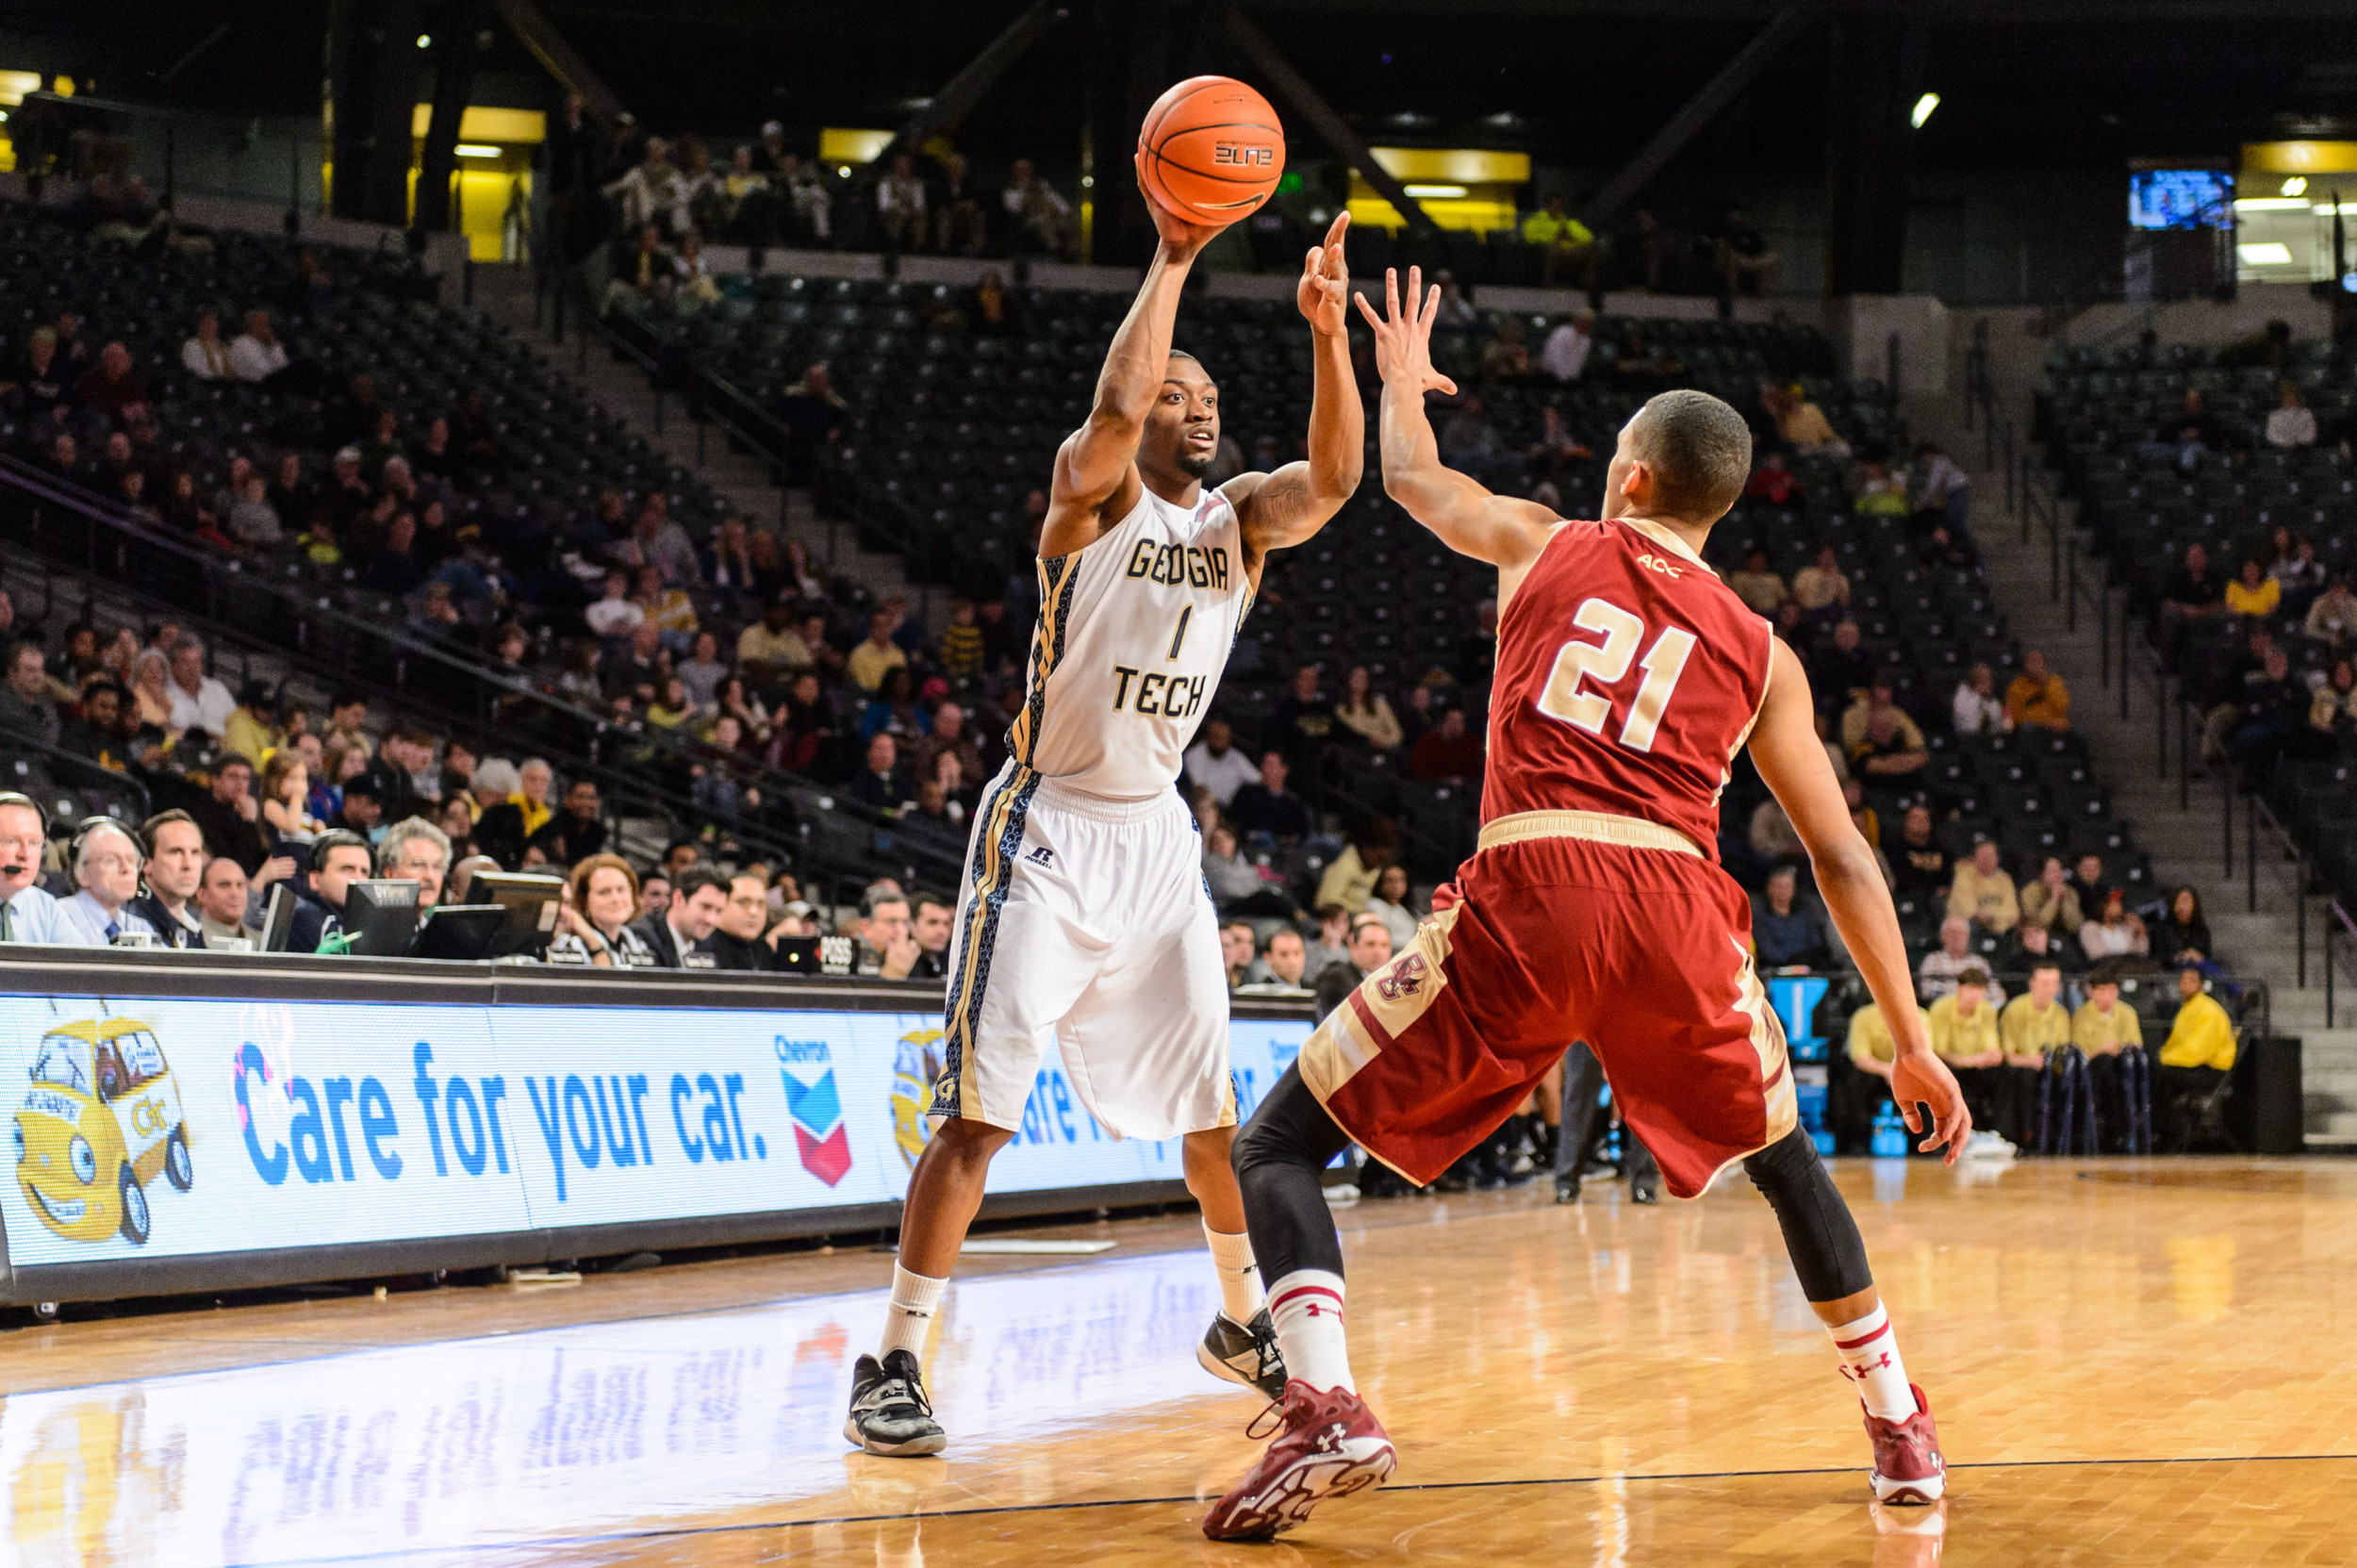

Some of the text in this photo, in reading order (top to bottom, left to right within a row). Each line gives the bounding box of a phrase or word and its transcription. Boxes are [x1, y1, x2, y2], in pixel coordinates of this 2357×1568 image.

[1637, 553, 1683, 579] ACC
[1166, 603, 1194, 661] 1
[1113, 664, 1207, 718] TECH
[1537, 597, 1697, 752] 21
[1024, 854, 1053, 870] RUSSELL
[774, 1034, 831, 1063] Chevron
[235, 1041, 767, 1203] Care for your car.
